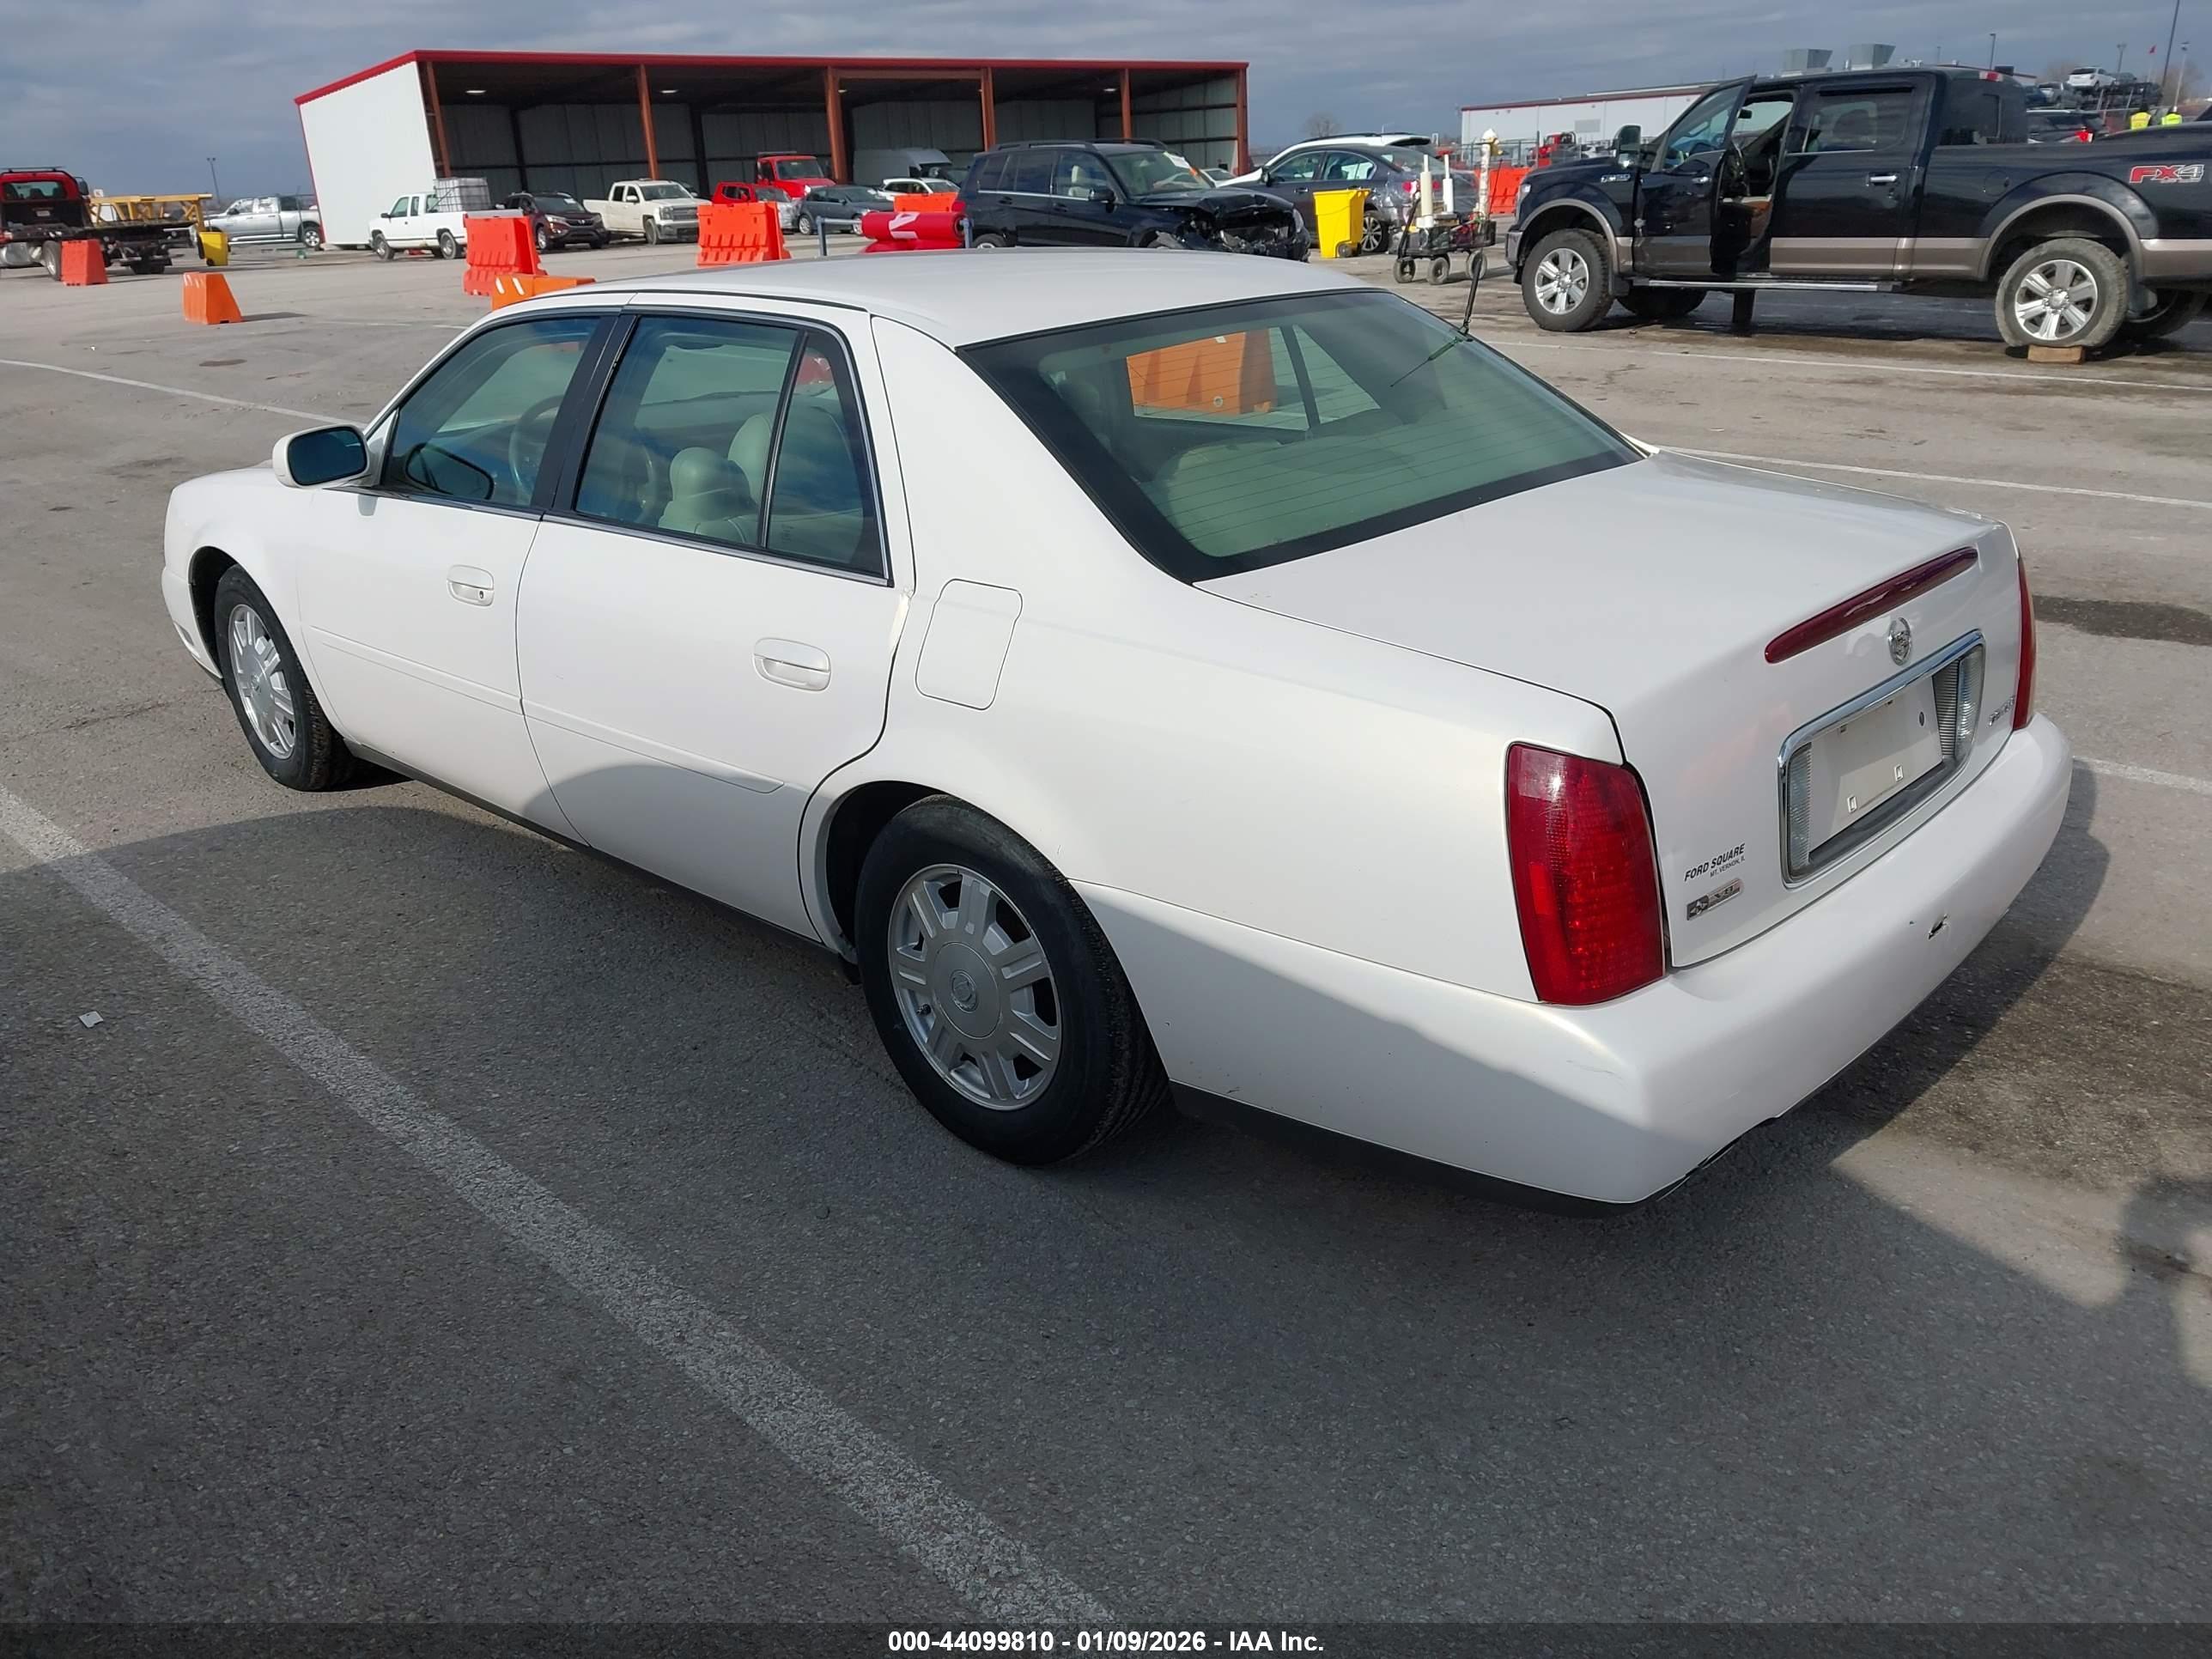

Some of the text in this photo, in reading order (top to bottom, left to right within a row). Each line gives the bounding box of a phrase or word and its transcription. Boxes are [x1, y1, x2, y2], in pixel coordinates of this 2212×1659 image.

[2130, 163, 2205, 184] FX4
[1684, 842, 1746, 882] FORD SQUARE
